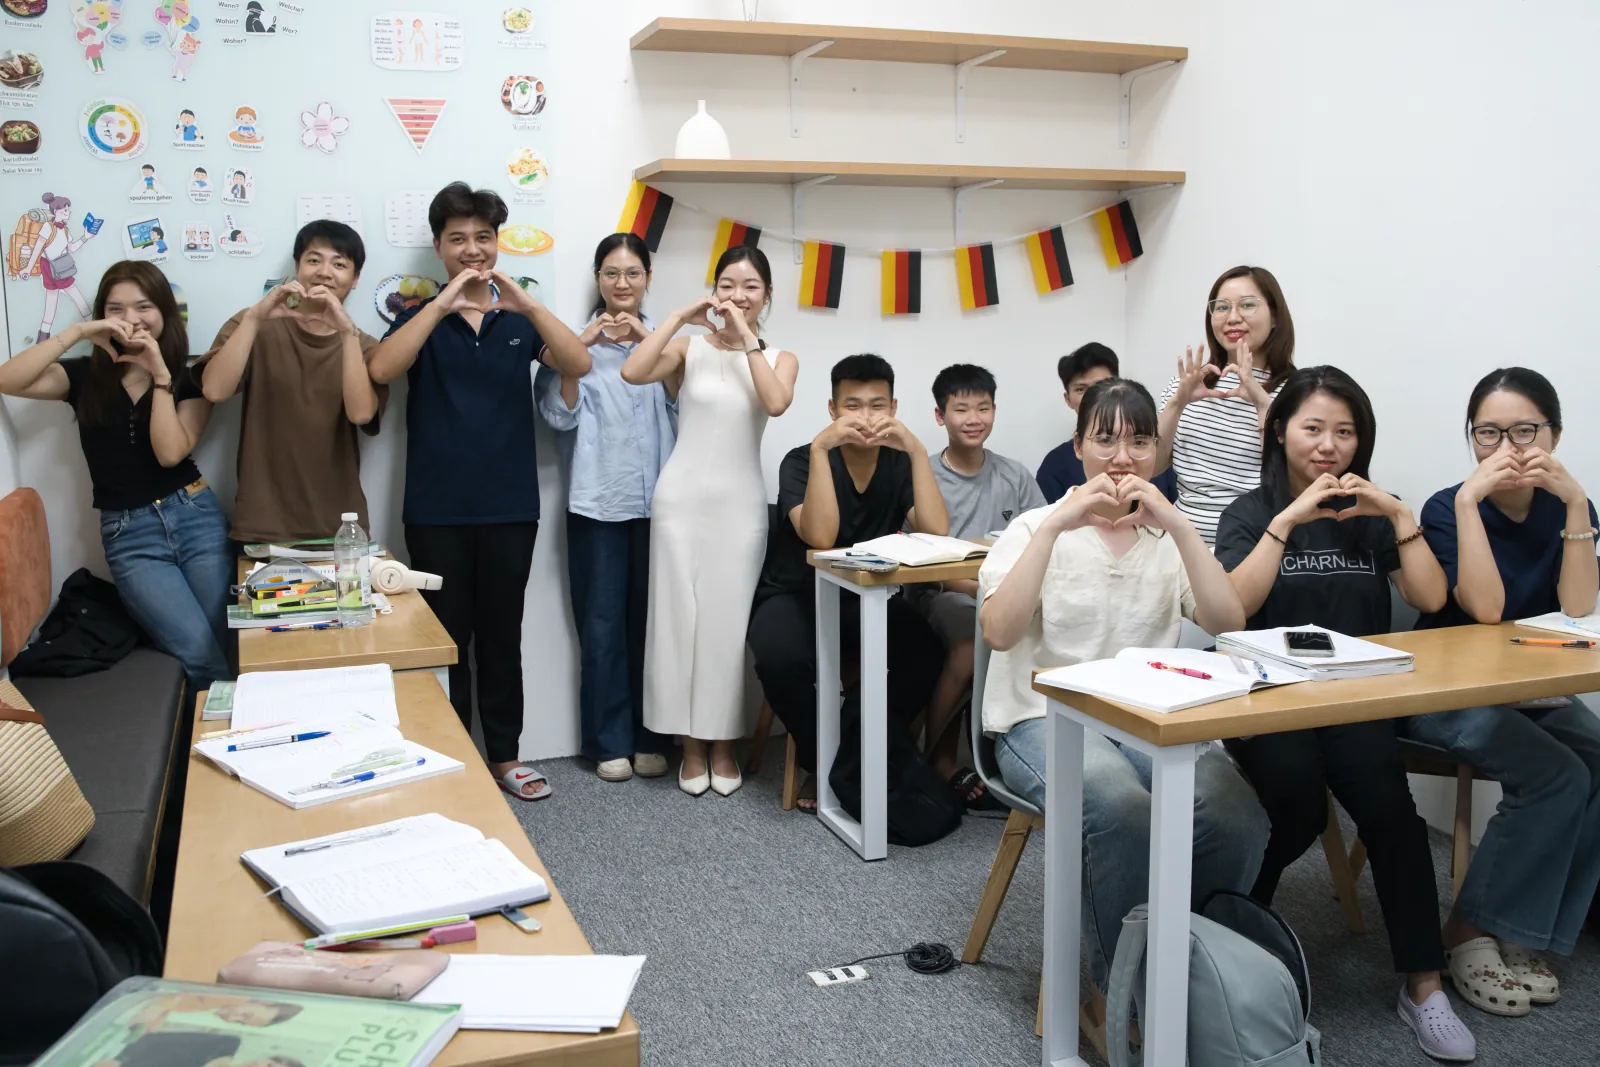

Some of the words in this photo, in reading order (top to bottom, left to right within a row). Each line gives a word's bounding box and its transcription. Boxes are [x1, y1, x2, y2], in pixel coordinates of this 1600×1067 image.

[218, 1, 239, 9] Wann?
[279, 2, 304, 13] Welche?
[282, 26, 298, 34] Wer?
[1283, 554, 1370, 570] CHARNEL
[325, 1023, 382, 1067] PLU
